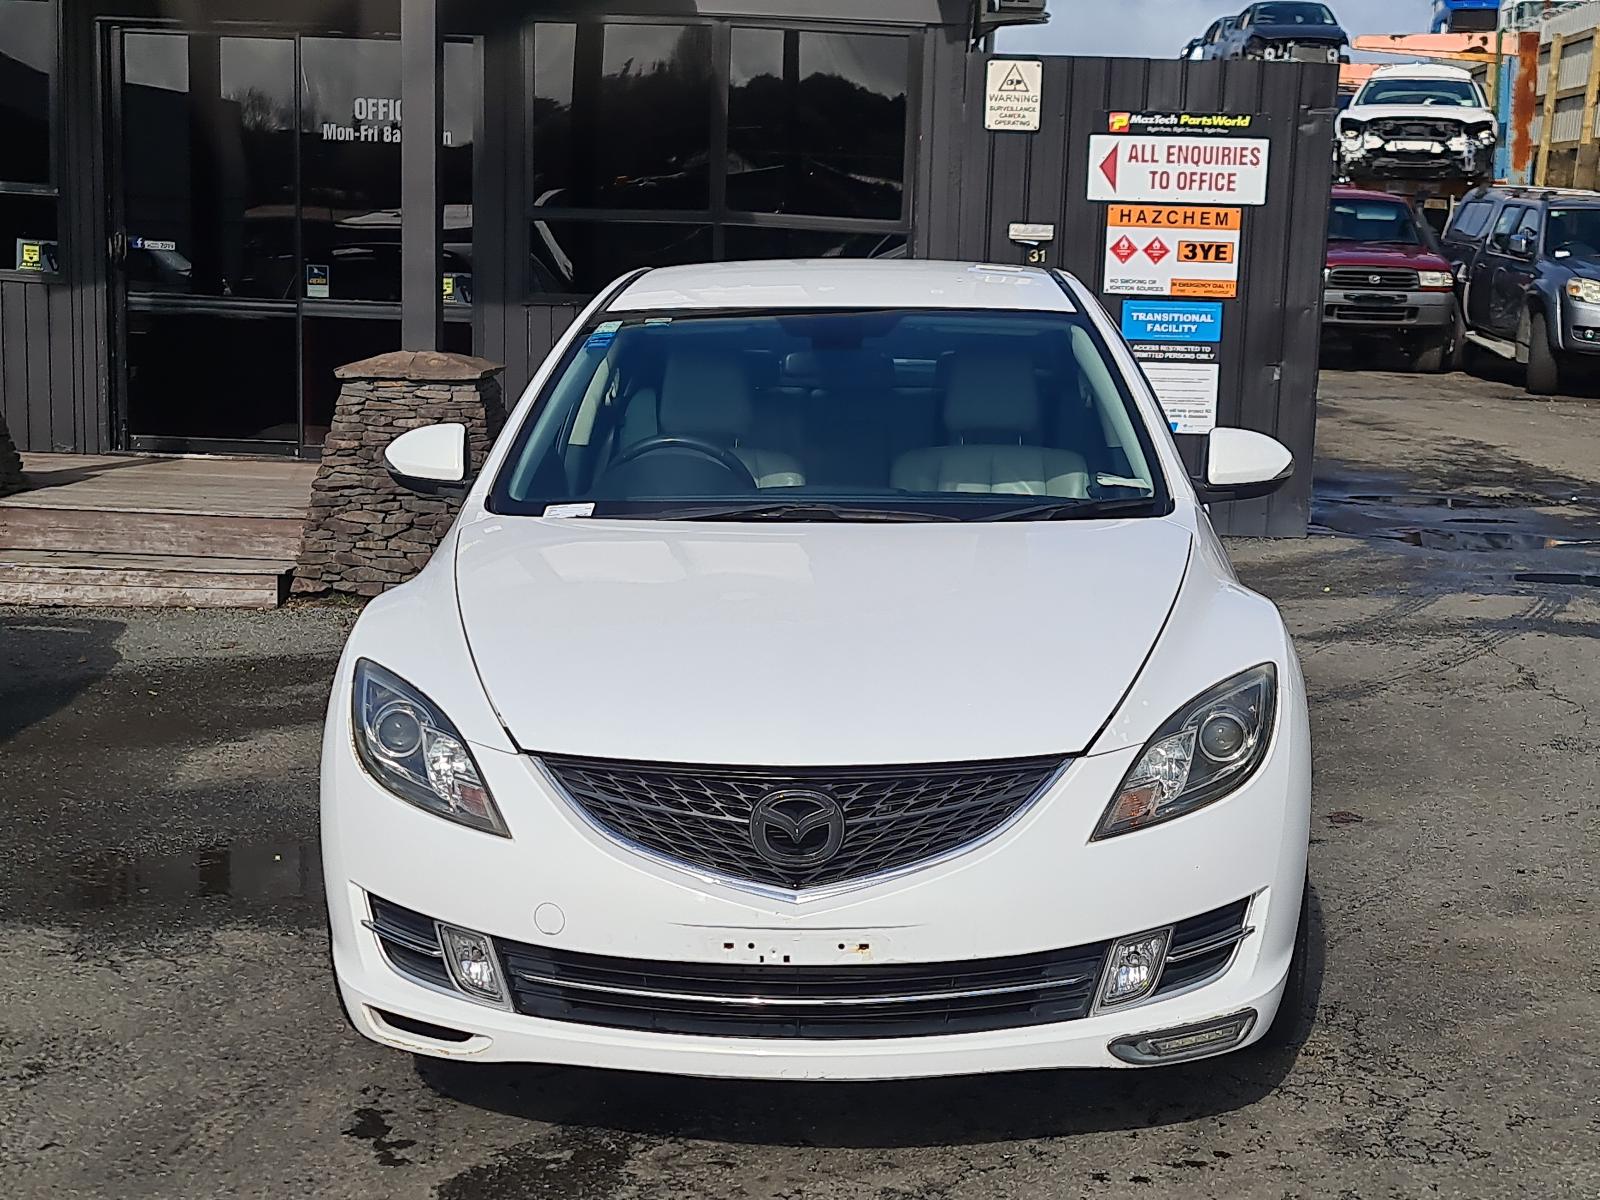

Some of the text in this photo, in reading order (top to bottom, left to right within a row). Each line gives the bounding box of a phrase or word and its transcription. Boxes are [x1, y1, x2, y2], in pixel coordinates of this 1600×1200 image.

[989, 94, 1038, 103] WARNING
[354, 97, 402, 121] OFFIC
[994, 119, 1031, 127] OPERATING
[1130, 114, 1178, 125] MazTech
[1180, 115, 1251, 127] PartsWorld
[323, 123, 378, 142] Mon-Fri
[1128, 144, 1261, 166] ALL ENQUIRIES
[1149, 171, 1237, 192] TO OFFICE
[1120, 209, 1229, 226] HAZCHEM
[1029, 249, 1046, 262] 31
[1183, 243, 1228, 261] 3YE
[1131, 312, 1214, 323] TRANSITIONAL
[1146, 323, 1198, 333] FACILITY
